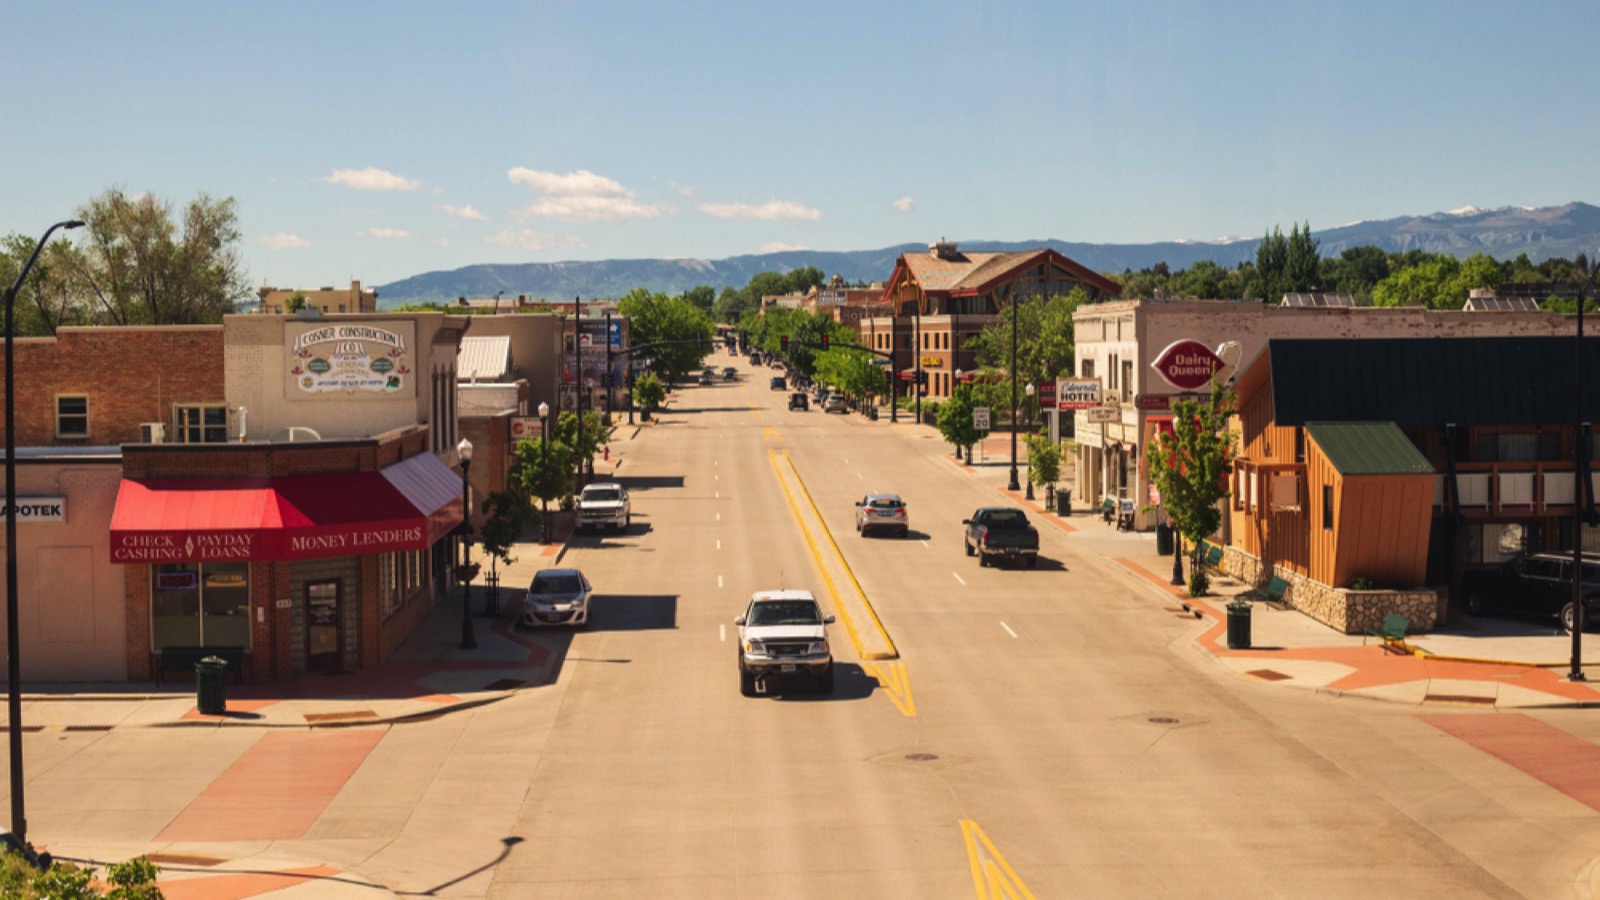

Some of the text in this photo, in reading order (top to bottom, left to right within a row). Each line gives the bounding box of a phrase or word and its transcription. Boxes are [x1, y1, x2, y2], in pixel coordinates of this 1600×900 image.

[303, 327, 396, 345] COSNER CONSTRUCTION
[1175, 353, 1211, 368] Dairy
[1169, 365, 1211, 378] Queen
[1060, 392, 1098, 402] HOTEL
[975, 420, 988, 428] 20
[122, 535, 174, 547] CHECK
[197, 534, 253, 547] PAYDAY
[292, 534, 348, 551] MONEY
[114, 547, 182, 560] CASHING
[201, 546, 251, 558] LOANS
